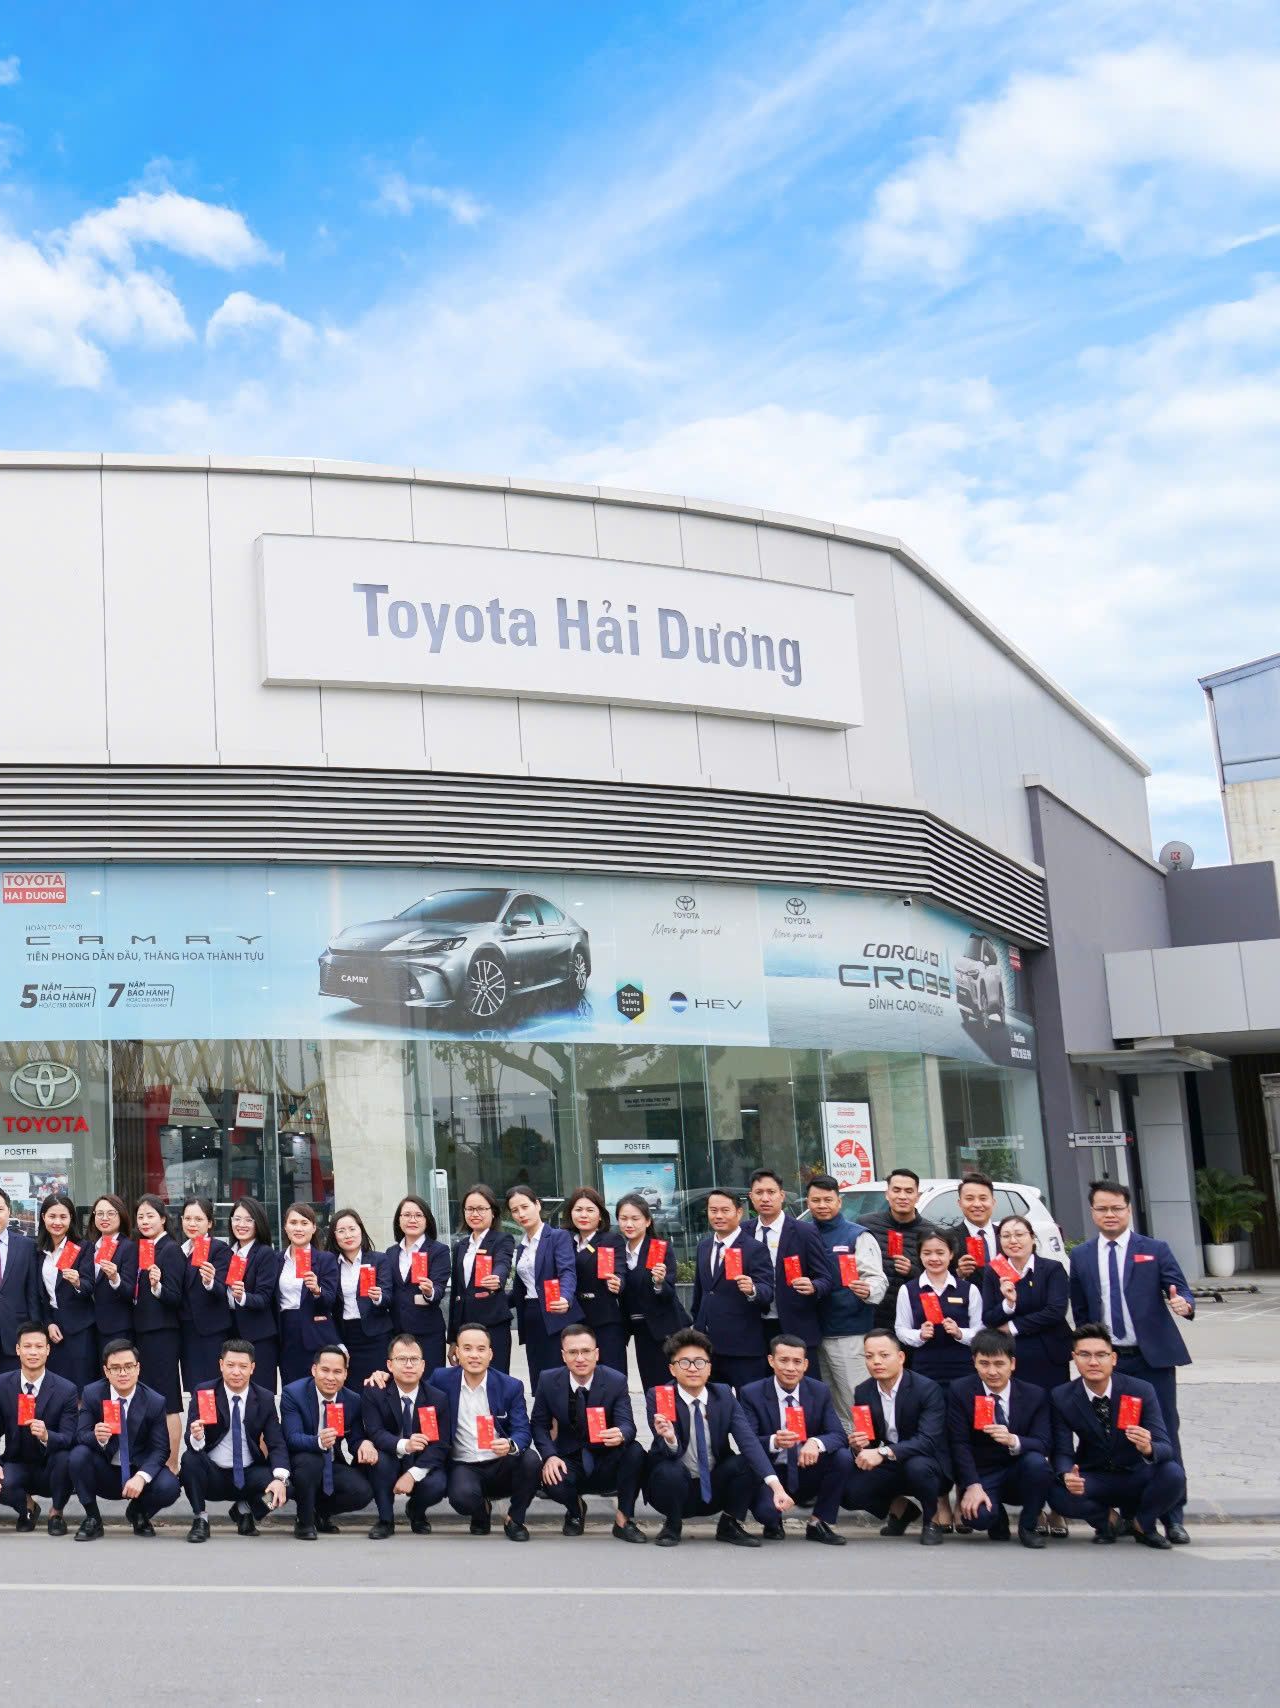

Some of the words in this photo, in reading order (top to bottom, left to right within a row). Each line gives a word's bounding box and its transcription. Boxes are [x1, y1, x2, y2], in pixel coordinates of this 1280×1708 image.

[353, 583, 538, 654] Toyota
[557, 597, 641, 657] Hải
[658, 607, 803, 687] Dương
[4, 874, 64, 887] TOYOTA
[25, 890, 65, 900] DUONG
[673, 912, 700, 920] TOYOTA
[784, 916, 811, 924] TOYOTA
[651, 923, 678, 937] Move
[680, 928, 698, 940] your
[701, 926, 721, 936] world
[25, 935, 263, 945] CAMRY
[27, 950, 49, 961] TIÊN
[51, 952, 90, 961] PHONG
[92, 949, 114, 961] DẪN
[116, 949, 142, 963] ĐẦU,
[144, 949, 179, 961] THĂNG
[182, 952, 206, 961] HOA
[208, 949, 242, 961] THÀNH
[244, 951, 265, 963] TỰU
[863, 943, 929, 964] COROLLA
[128, 980, 146, 988] NĂM
[341, 975, 368, 984] CAMRY
[839, 964, 951, 999] CROSS
[41, 982, 62, 991] NĂM
[20, 984, 39, 1009] 5
[62, 990, 91, 1001] HÀNH
[107, 983, 126, 1007] 7
[145, 988, 170, 997] HÀNH
[695, 999, 743, 1010] HEV
[869, 995, 894, 1010] ĐỈNH
[896, 1000, 917, 1011] CAO
[3, 1116, 90, 1133] TOYOTA
[4, 1148, 38, 1156] POSTER
